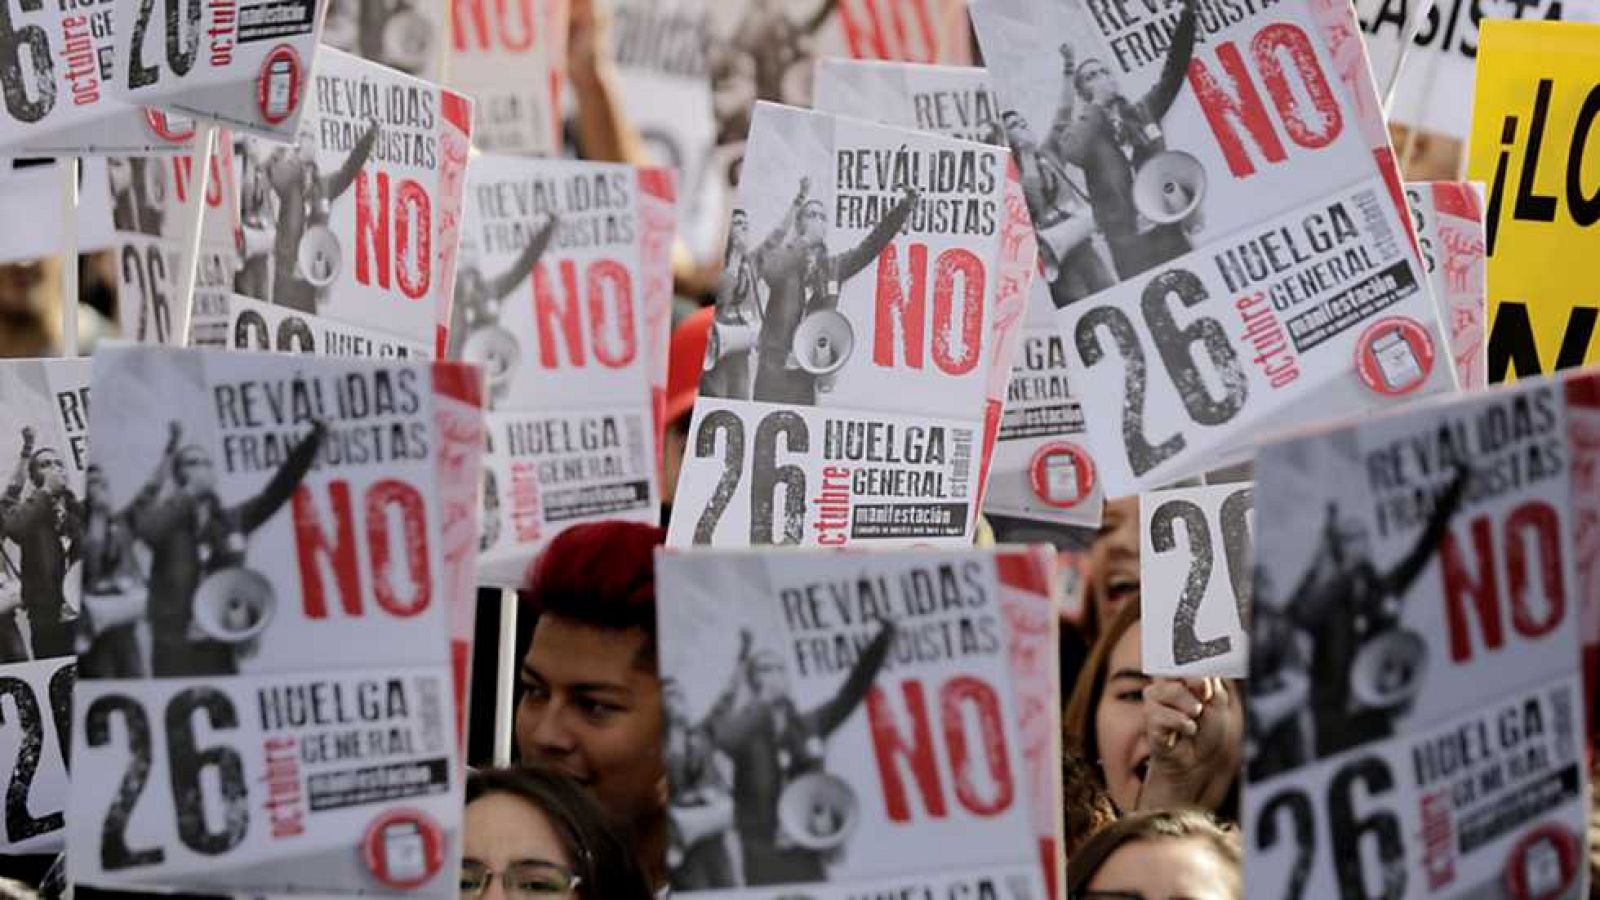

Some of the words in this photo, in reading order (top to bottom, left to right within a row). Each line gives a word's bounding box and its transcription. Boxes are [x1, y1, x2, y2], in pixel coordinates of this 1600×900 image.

[60, 15, 100, 106] octubre
[316, 74, 435, 130] REVÁLIDAS
[1187, 22, 1343, 179] NO
[836, 143, 997, 195] REVÁLIDAS
[353, 168, 431, 300] NO
[1214, 201, 1359, 294] HUELGA
[1268, 245, 1381, 311] GENERAL
[532, 258, 638, 370] NO
[874, 243, 985, 376] NO
[1235, 291, 1299, 389] octubre
[214, 368, 420, 429] REVÁLIDAS
[1075, 268, 1249, 477] 26
[507, 416, 620, 456] HUELGA
[687, 408, 812, 546] 26
[823, 419, 946, 465] HUELGA
[852, 467, 948, 498] GENERAL
[292, 478, 433, 620] NO
[811, 466, 852, 547] ctubre
[1438, 500, 1566, 662] NO
[257, 677, 409, 731] HUELGA
[863, 673, 1016, 823] NO
[84, 684, 250, 872] 26
[1255, 753, 1405, 900] 26
